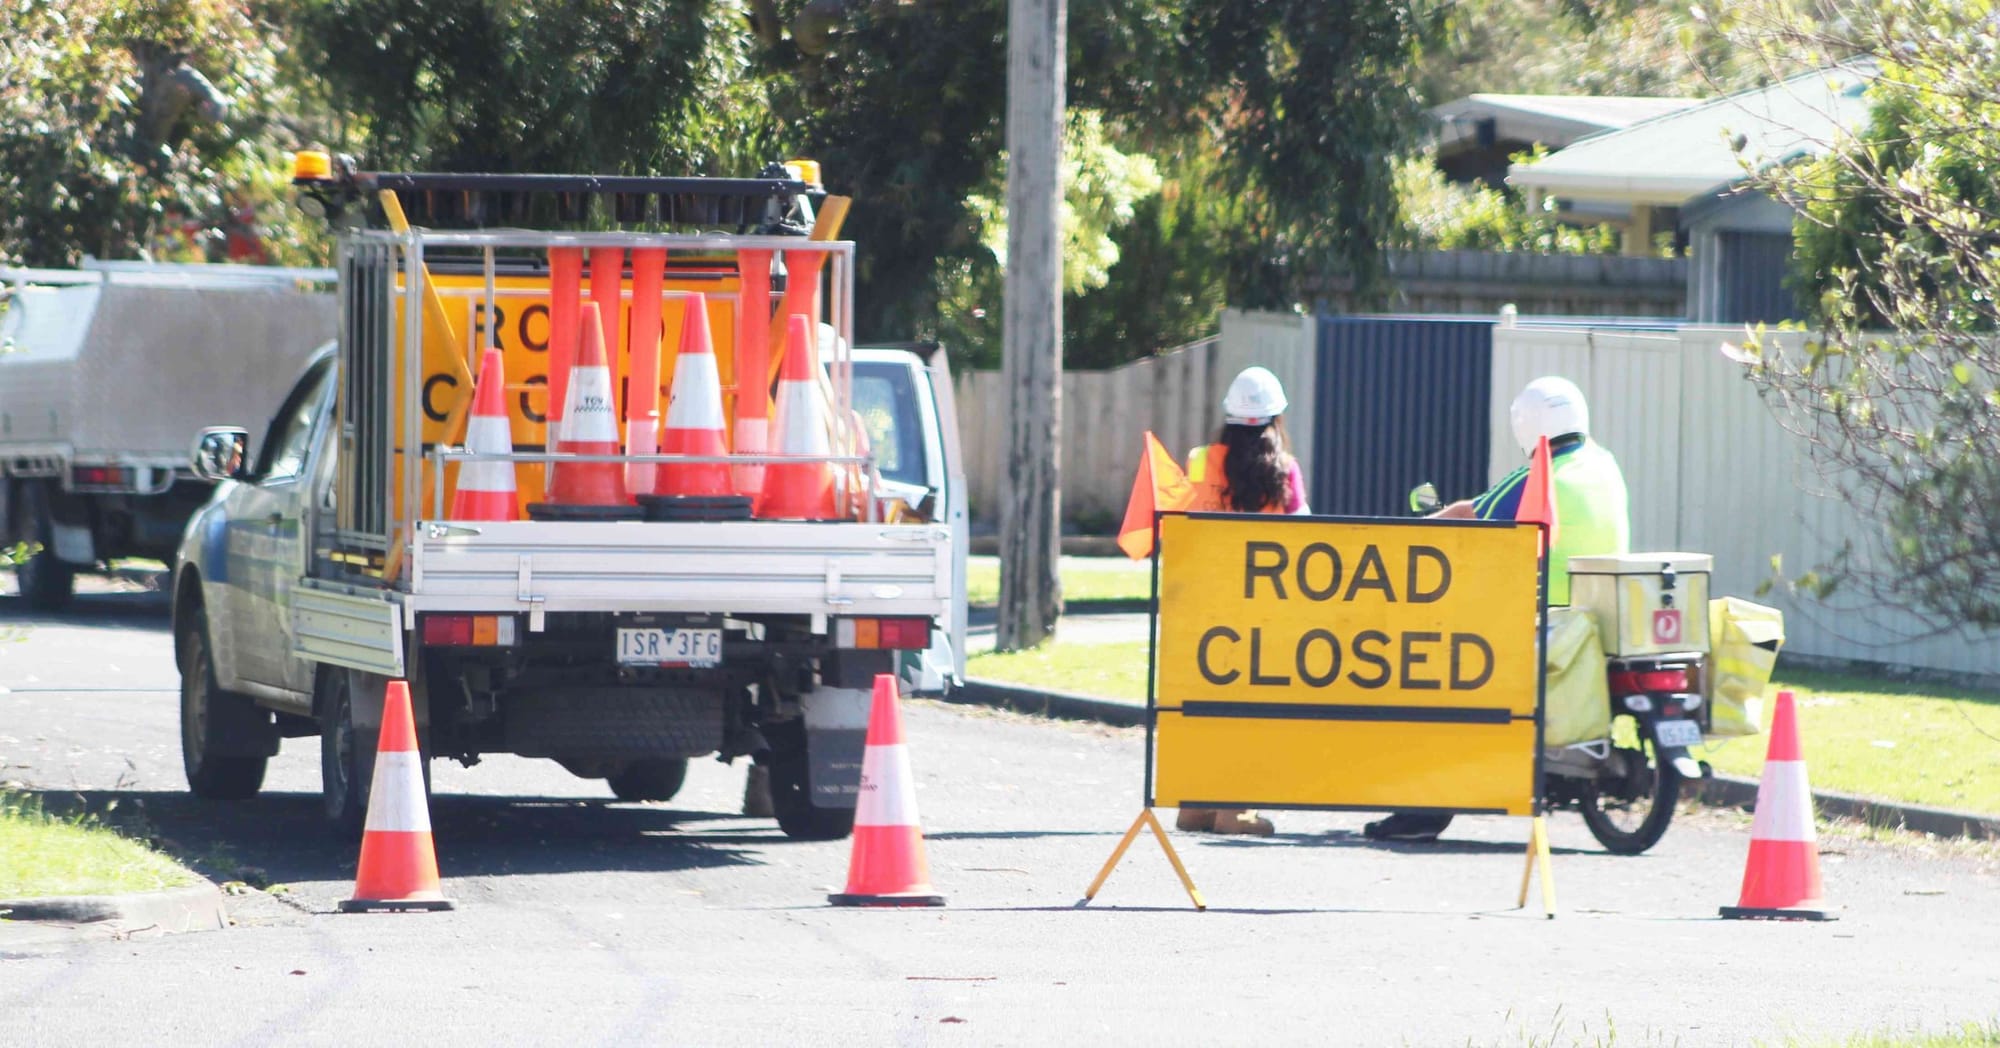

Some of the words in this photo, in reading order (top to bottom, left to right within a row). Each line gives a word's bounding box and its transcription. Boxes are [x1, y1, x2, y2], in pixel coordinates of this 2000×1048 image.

[1244, 541, 1452, 603] ROAD
[623, 632, 659, 656] 1SR
[677, 632, 719, 656] 3FG
[1197, 626, 1494, 691] CLOSED
